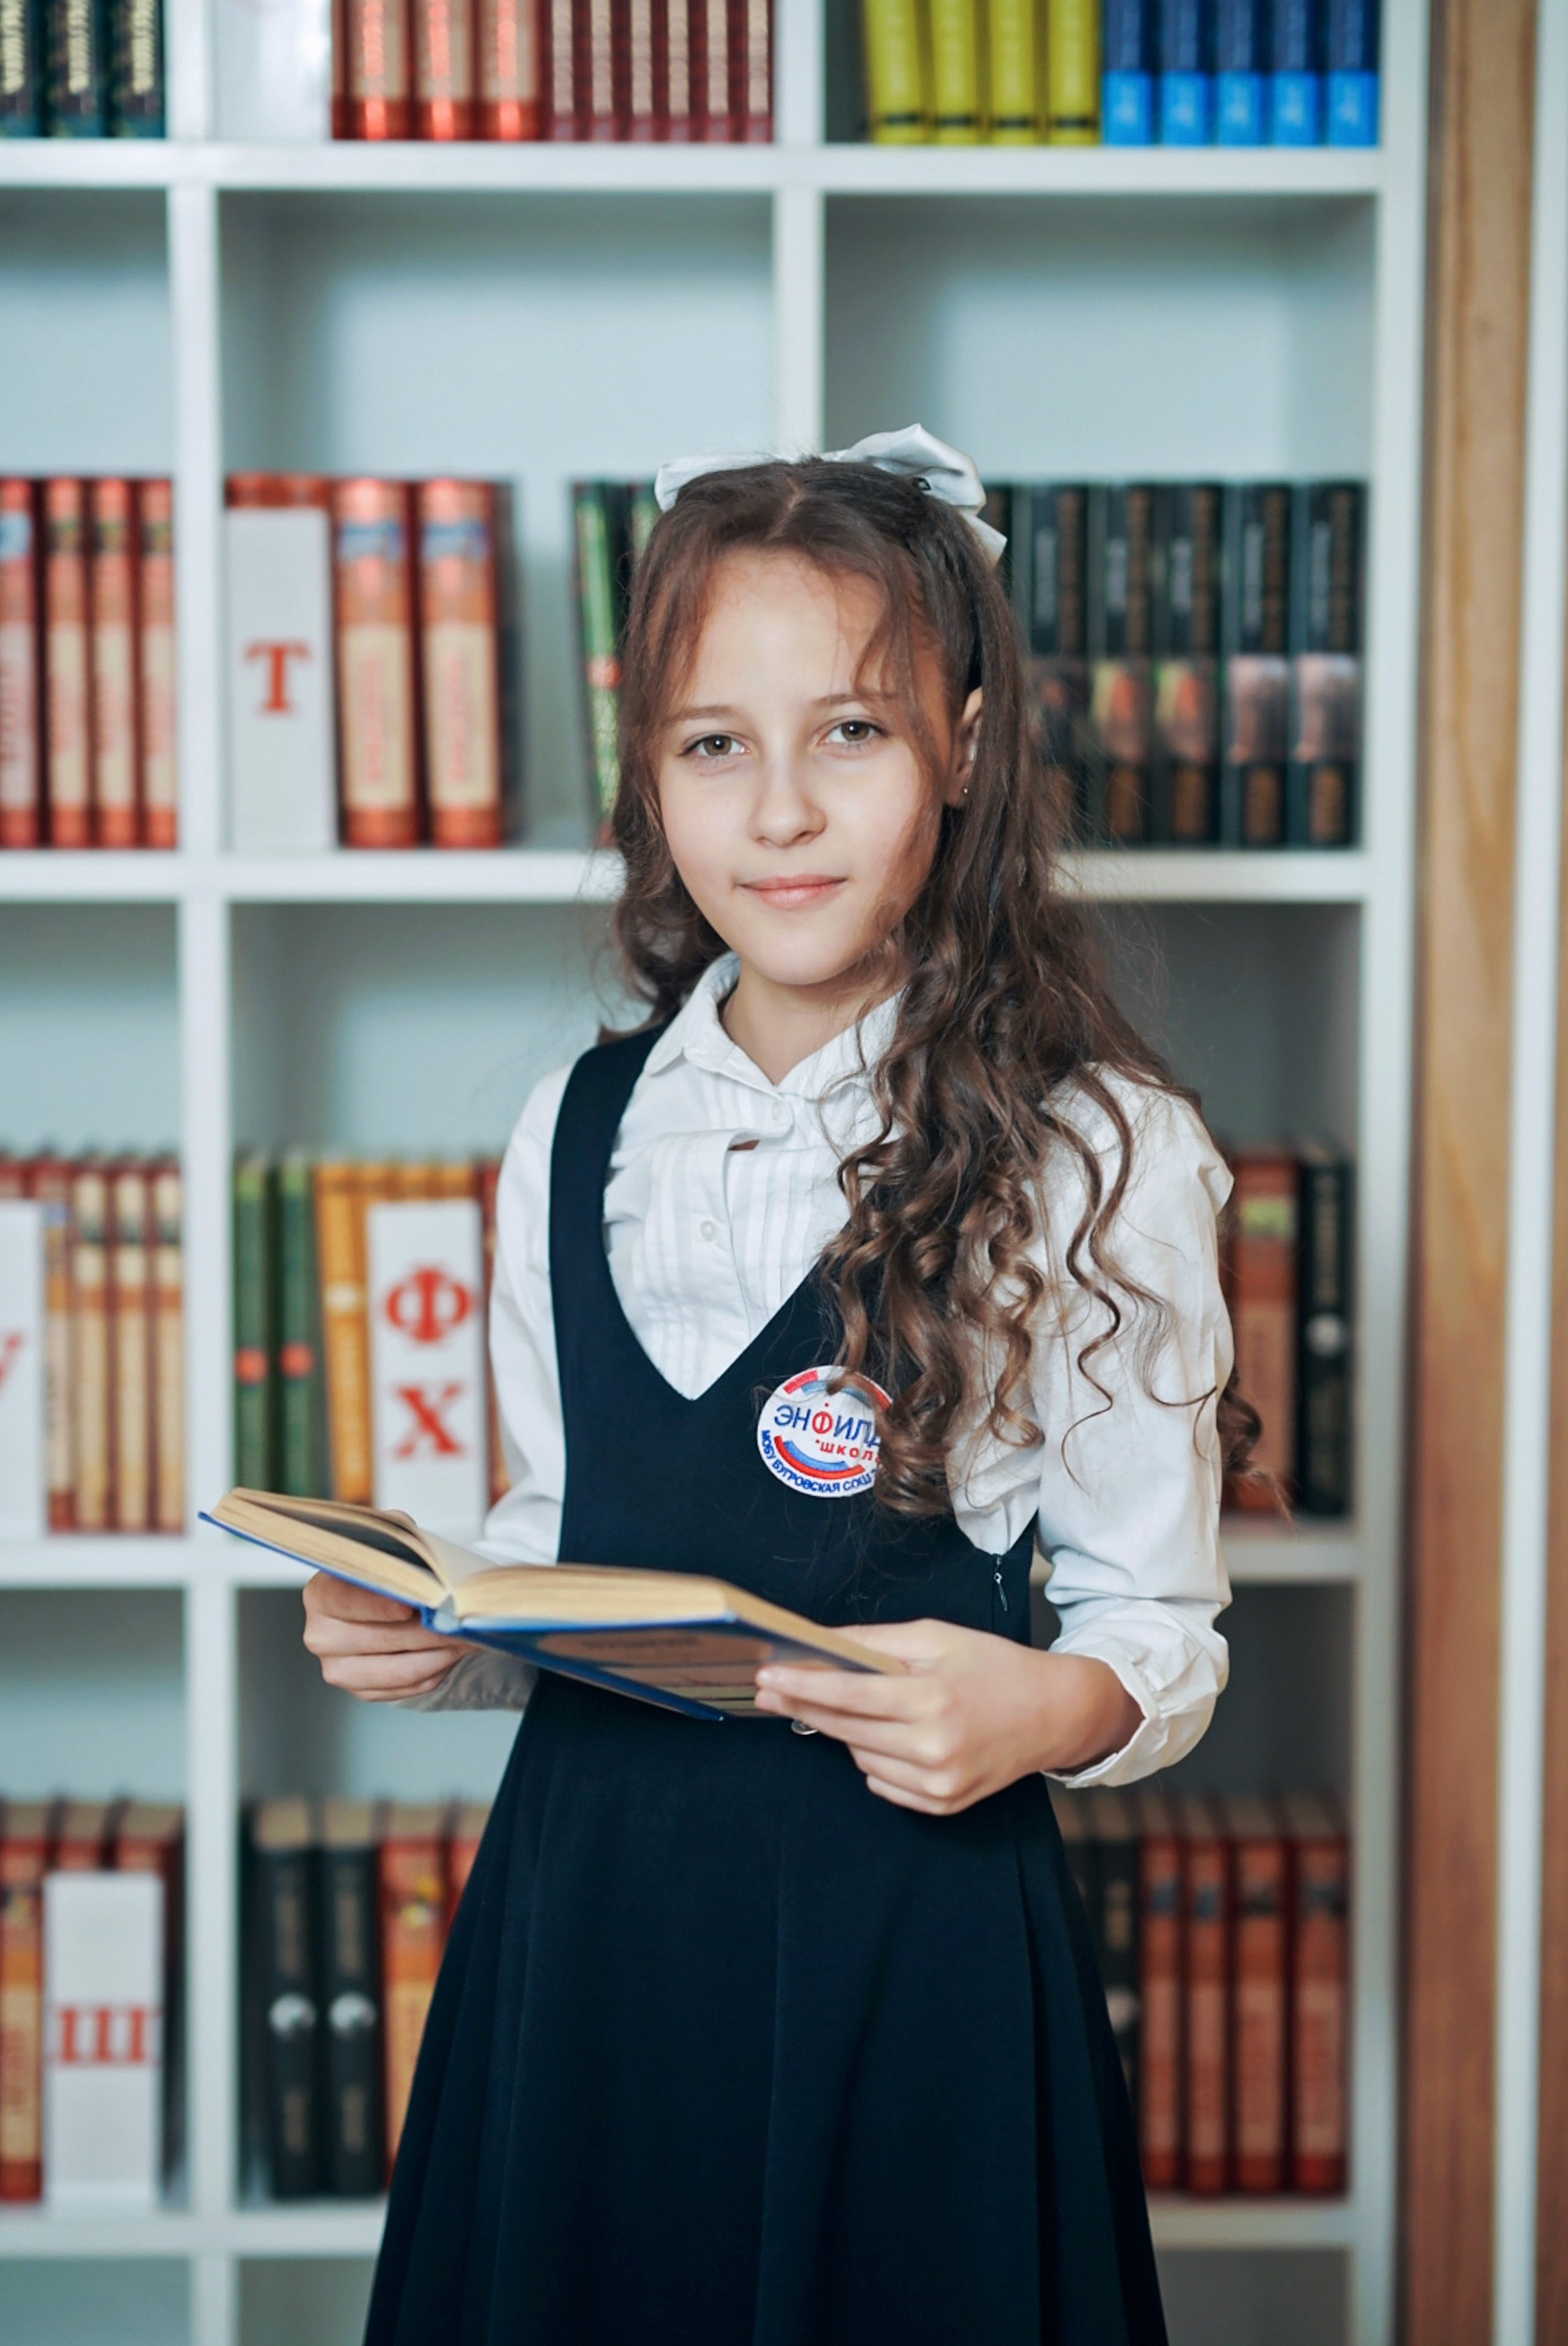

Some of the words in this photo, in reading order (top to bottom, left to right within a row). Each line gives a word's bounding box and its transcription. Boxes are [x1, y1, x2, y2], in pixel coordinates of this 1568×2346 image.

[243, 638, 312, 714] Т
[385, 1265, 475, 1344] Ф
[395, 1380, 463, 1457] Х
[772, 1458, 840, 1493] БУГРОВСКАЯ
[843, 1473, 872, 1492] СОШ
